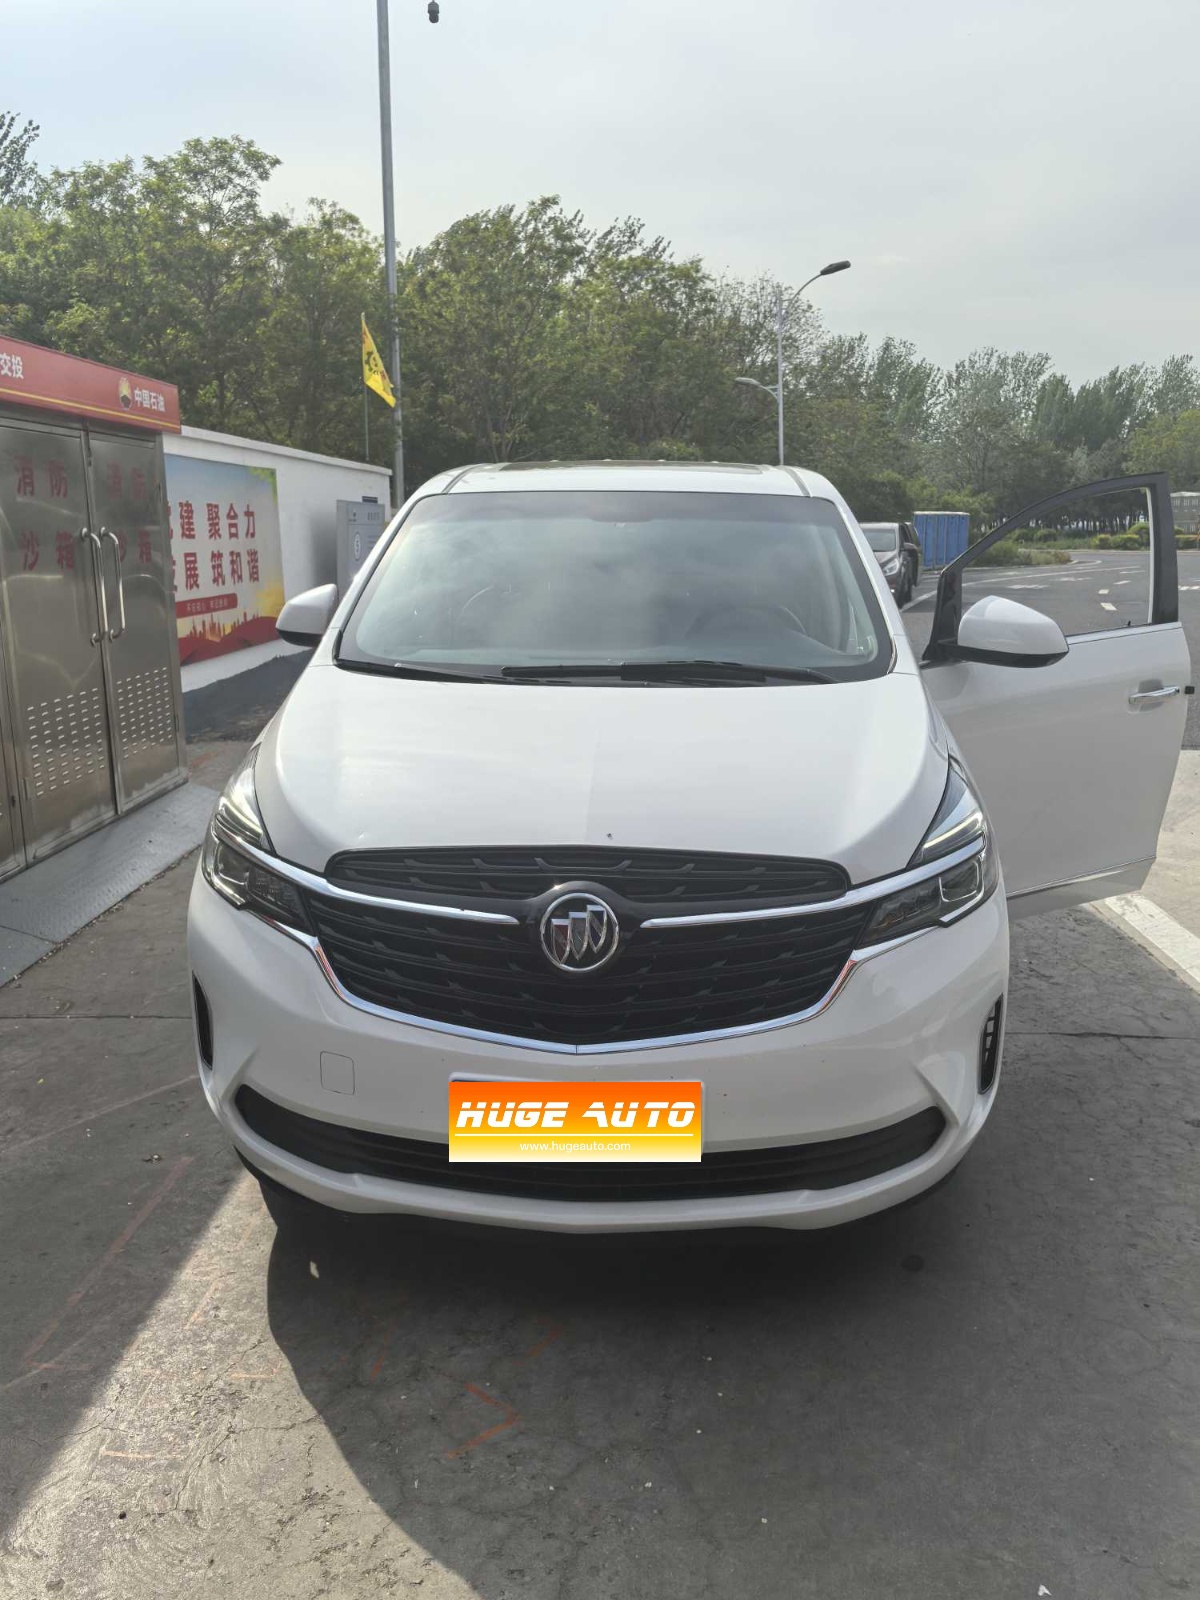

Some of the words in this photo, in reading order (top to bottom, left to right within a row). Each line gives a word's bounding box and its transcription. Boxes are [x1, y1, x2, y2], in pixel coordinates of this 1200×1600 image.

[134, 387, 165, 412] 中国石油
[206, 502, 256, 540] 聚合力
[172, 551, 200, 592] 展
[210, 548, 260, 587] 筑和谐
